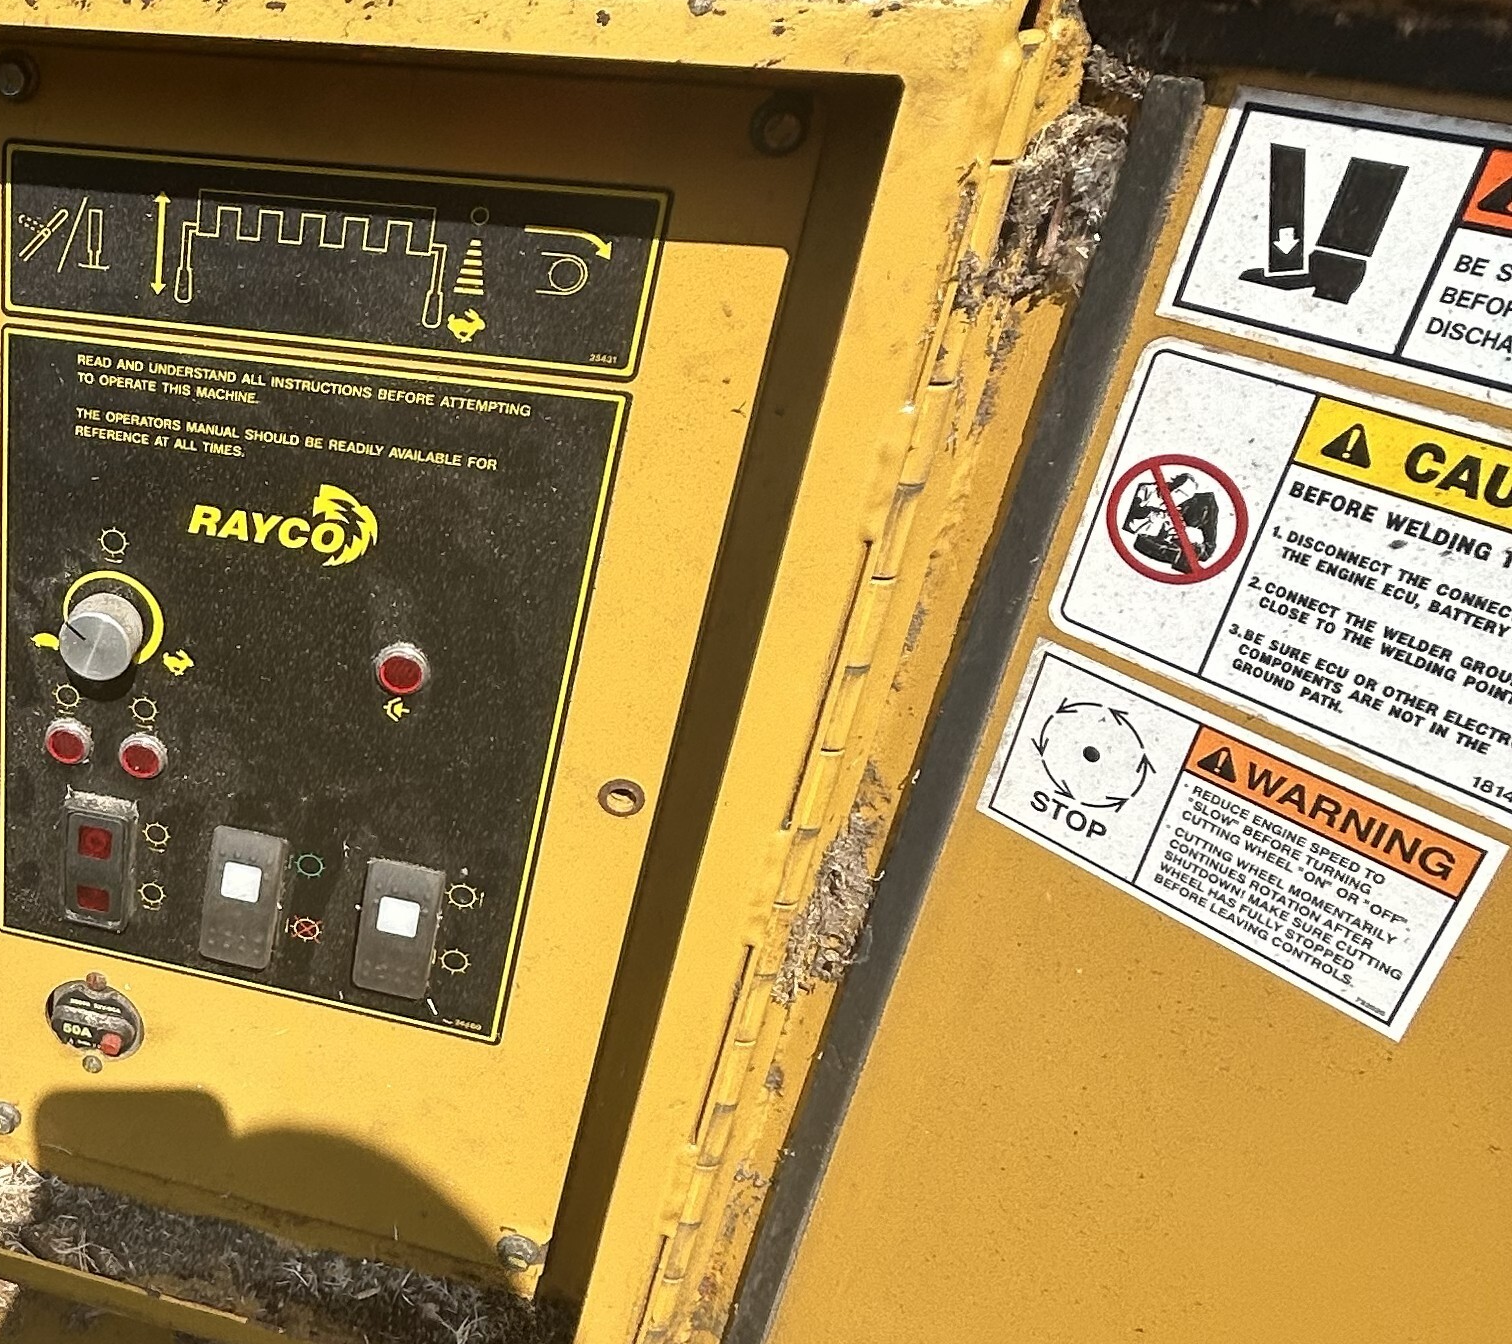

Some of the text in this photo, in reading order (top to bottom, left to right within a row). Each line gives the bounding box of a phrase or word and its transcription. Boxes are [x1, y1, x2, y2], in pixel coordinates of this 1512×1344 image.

[1453, 254, 1490, 277] BE
[77, 354, 531, 417] READ AND UNDERSTAND ALL INSTRUCTIONS BEFORE ATTEMPTING
[77, 371, 260, 404] TO OPERATE THIS MACHINE.
[75, 425, 149, 445] REFERENCE
[154, 435, 169, 447] AT
[173, 438, 197, 451] ALL
[76, 407, 498, 471] THE OPERATORS MANUAL SHOULD BE READILY AVAILABLE FOR
[187, 504, 345, 553] RAYCO
[1286, 530, 1393, 576] DISCONNECT
[1397, 568, 1432, 590] THE
[1288, 481, 1378, 523] BEFORE
[1386, 511, 1492, 561] WELDING
[1282, 546, 1511, 637] THE ENGINE ECU, BATTERY
[1259, 596, 1310, 624] CLOSE
[1316, 618, 1336, 634] TO
[1342, 628, 1375, 649] THE
[1380, 642, 1457, 682] WELDING
[1265, 582, 1341, 618] CONNECT
[1345, 611, 1377, 633] THE
[1383, 625, 1453, 662] WELDER
[1460, 655, 1512, 686] GROU
[1232, 658, 1343, 713] GROUND PATH.
[1238, 644, 1491, 755] COMPONENTS ARE NOT IN THE
[1243, 629, 1265, 646] BE
[1269, 640, 1312, 665] SURE
[1315, 657, 1350, 679] ECU
[1354, 674, 1378, 691] OR
[1382, 686, 1439, 717] OTHER
[1442, 709, 1512, 748] ELECTR
[1030, 790, 1107, 838] STOP
[1192, 785, 1385, 885] REDUCE ENGINE SPEED TO
[1247, 761, 1456, 881] WARNING
[1169, 839, 1374, 950] CONTINUES ROTATION AFTER
[1175, 827, 1398, 944] CUTTING WHEEL MOMENTARILY
[1182, 810, 1241, 846] CUTTING
[1245, 840, 1293, 873] WHEEL
[1336, 887, 1359, 905] OR
[1242, 825, 1303, 861] BEFORE
[1305, 855, 1372, 895] TURNING
[1154, 873, 1208, 908] BEFORE
[1209, 903, 1269, 941] LEAVING
[1160, 861, 1354, 970] WHEEL HAS FULLY STOPPED
[1248, 893, 1290, 922] MAKE
[1291, 917, 1333, 944] SURE
[1336, 940, 1403, 981] CUTTING
